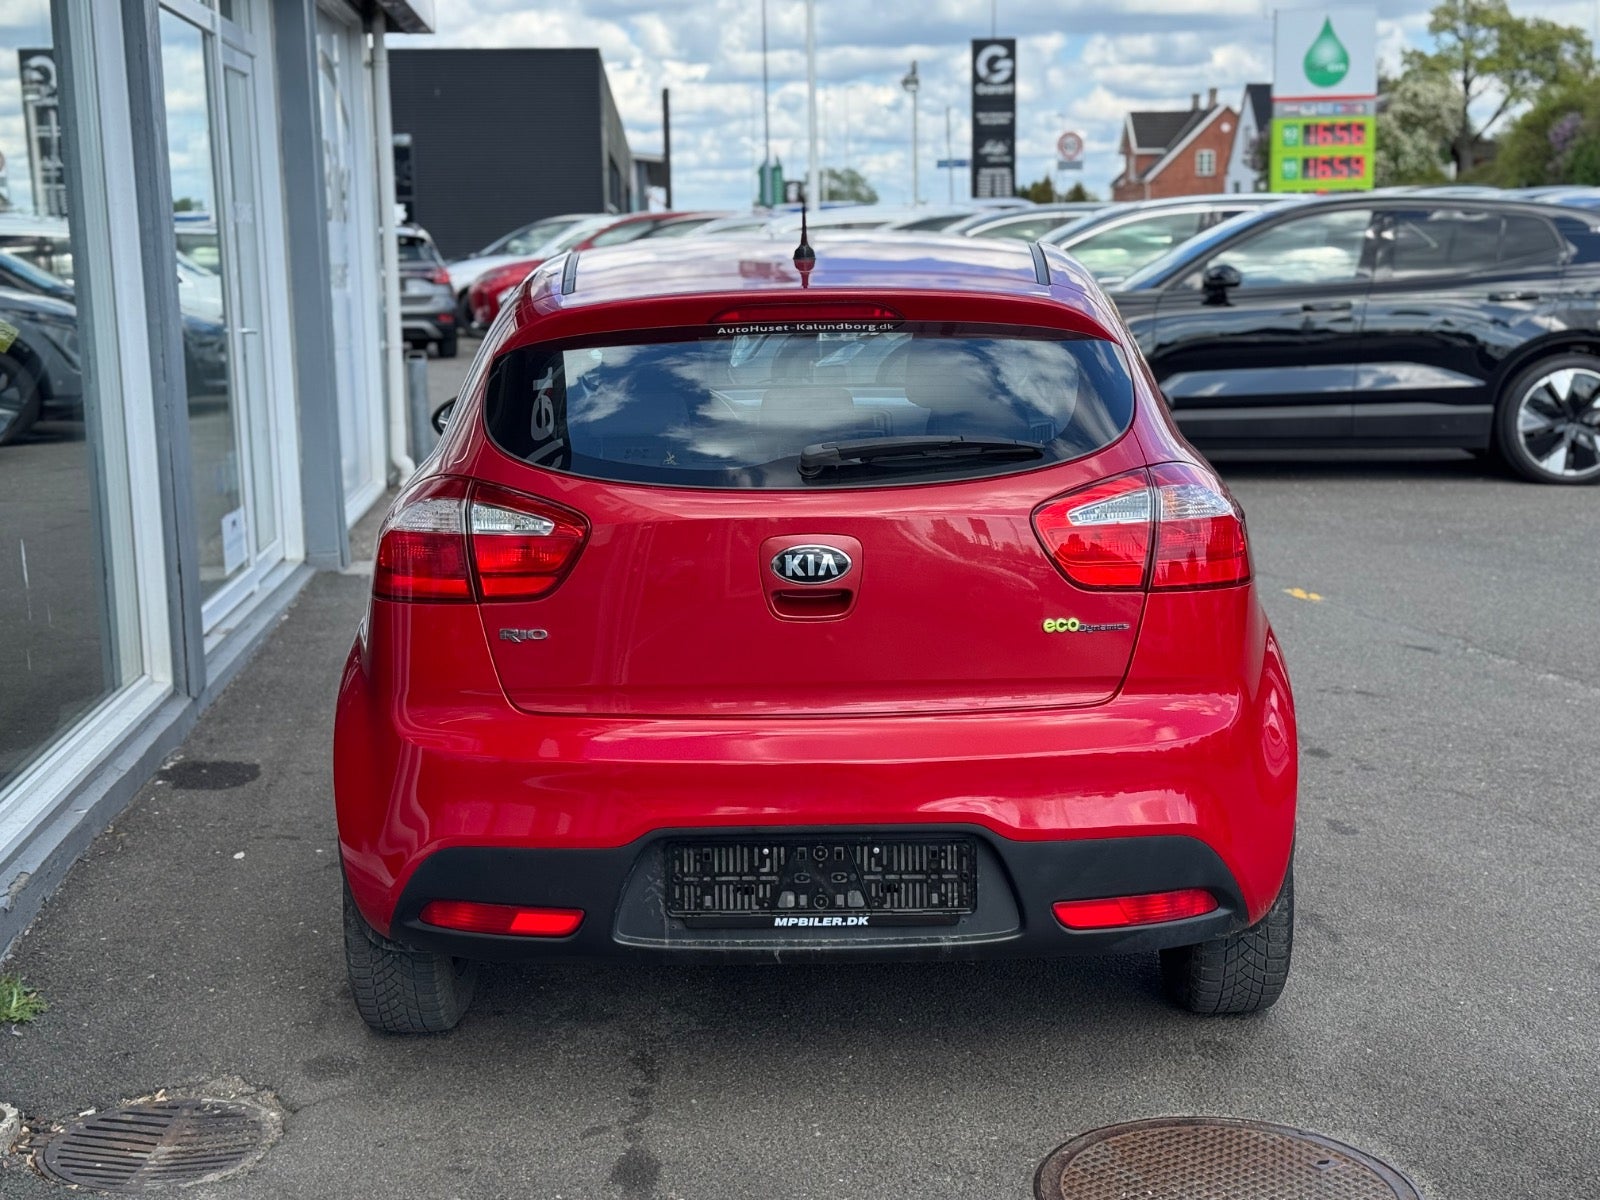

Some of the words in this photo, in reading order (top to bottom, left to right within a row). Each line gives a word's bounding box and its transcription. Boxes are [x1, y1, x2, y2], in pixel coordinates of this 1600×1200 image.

[717, 323, 894, 335] AutoHuset-Kalundborg.dk
[785, 554, 839, 577] KIA
[499, 628, 548, 642] RIO
[774, 916, 869, 927] MPBILER.DK
